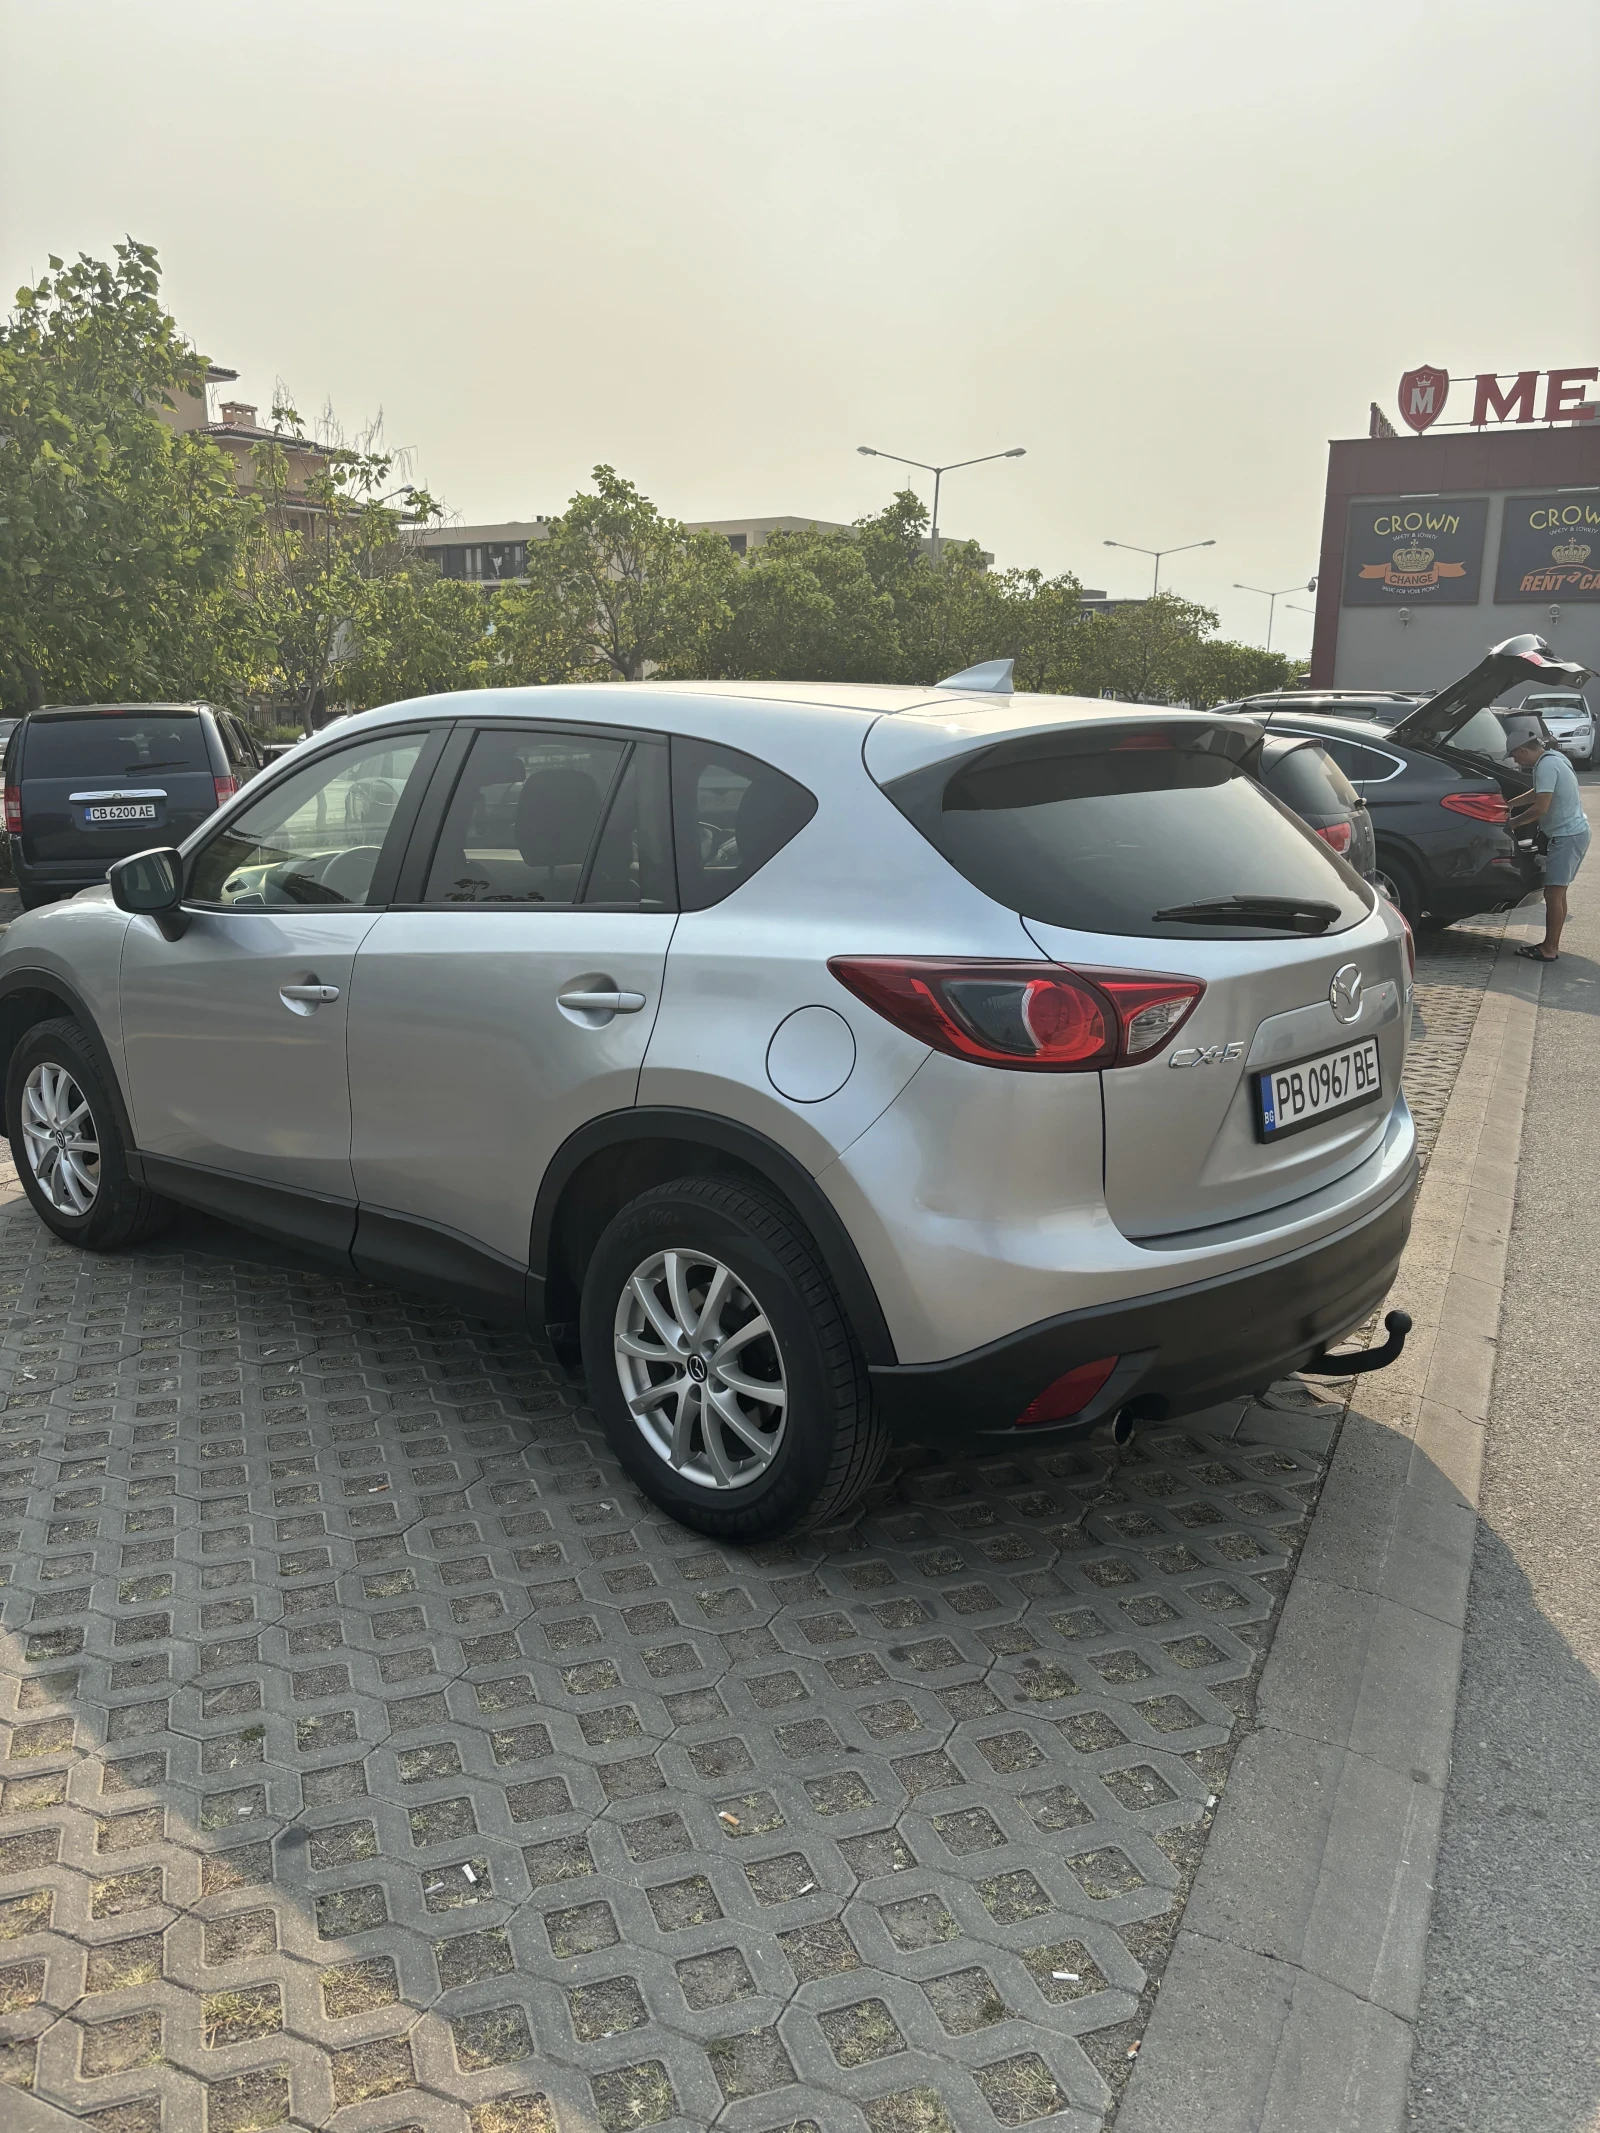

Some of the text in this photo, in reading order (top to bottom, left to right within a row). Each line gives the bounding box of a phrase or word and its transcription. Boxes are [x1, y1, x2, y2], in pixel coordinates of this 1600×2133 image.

[1409, 387, 1436, 415] M
[1470, 367, 1599, 426] ME
[1374, 512, 1460, 535] CROWN
[1389, 574, 1434, 585] CHANGE
[1519, 574, 1567, 592] RENT
[92, 808, 108, 819] CB
[109, 806, 137, 819] 6200
[139, 805, 154, 817] AE
[1168, 1041, 1245, 1069] CX-5
[1276, 1046, 1377, 1121] PB 0967 BE
[1264, 1110, 1275, 1125] BG
